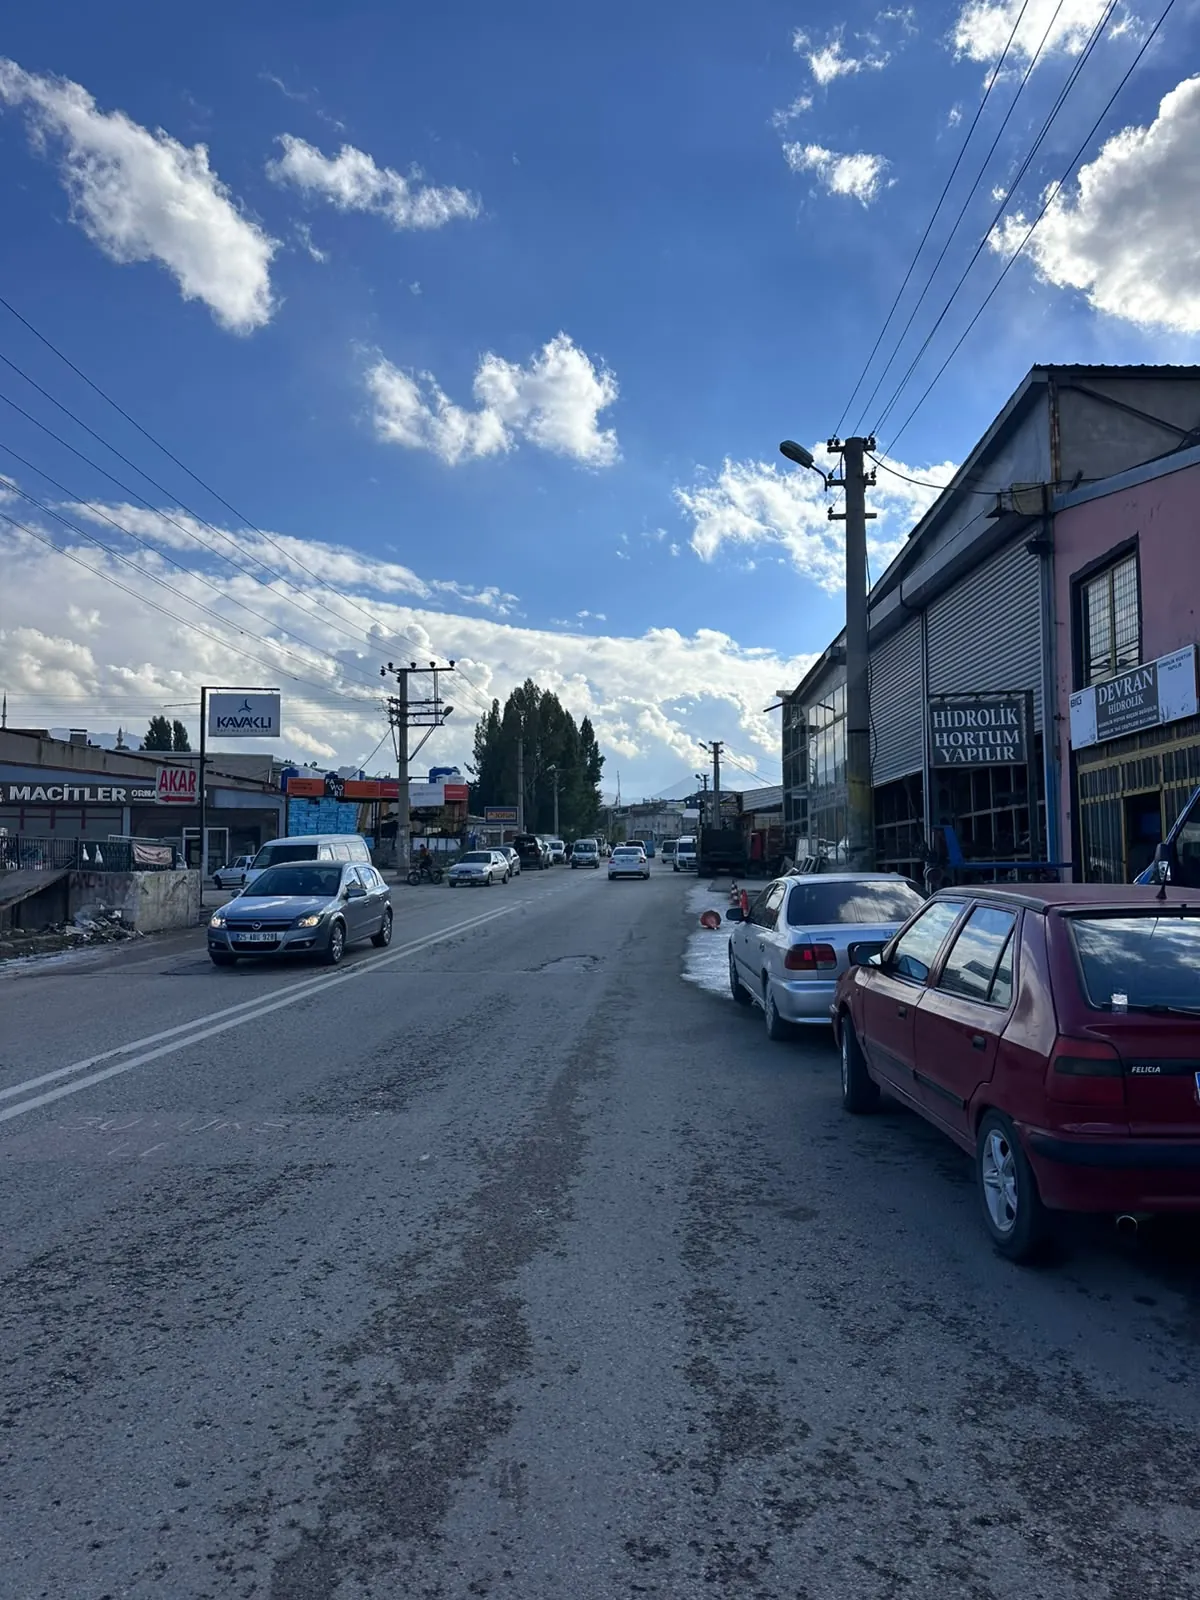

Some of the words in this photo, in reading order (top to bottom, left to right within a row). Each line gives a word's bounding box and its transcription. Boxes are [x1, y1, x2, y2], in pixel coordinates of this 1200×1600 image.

[1098, 667, 1154, 705] DEVRAN
[1108, 692, 1144, 715] HİDROLİK
[217, 716, 272, 728] KAVAKLI
[933, 703, 1018, 728] HİDROLİK
[934, 729, 1020, 747] HORTUM
[940, 746, 1016, 763] YAPILIR
[158, 769, 197, 792] AKAR
[10, 784, 127, 802] MACİTLER
